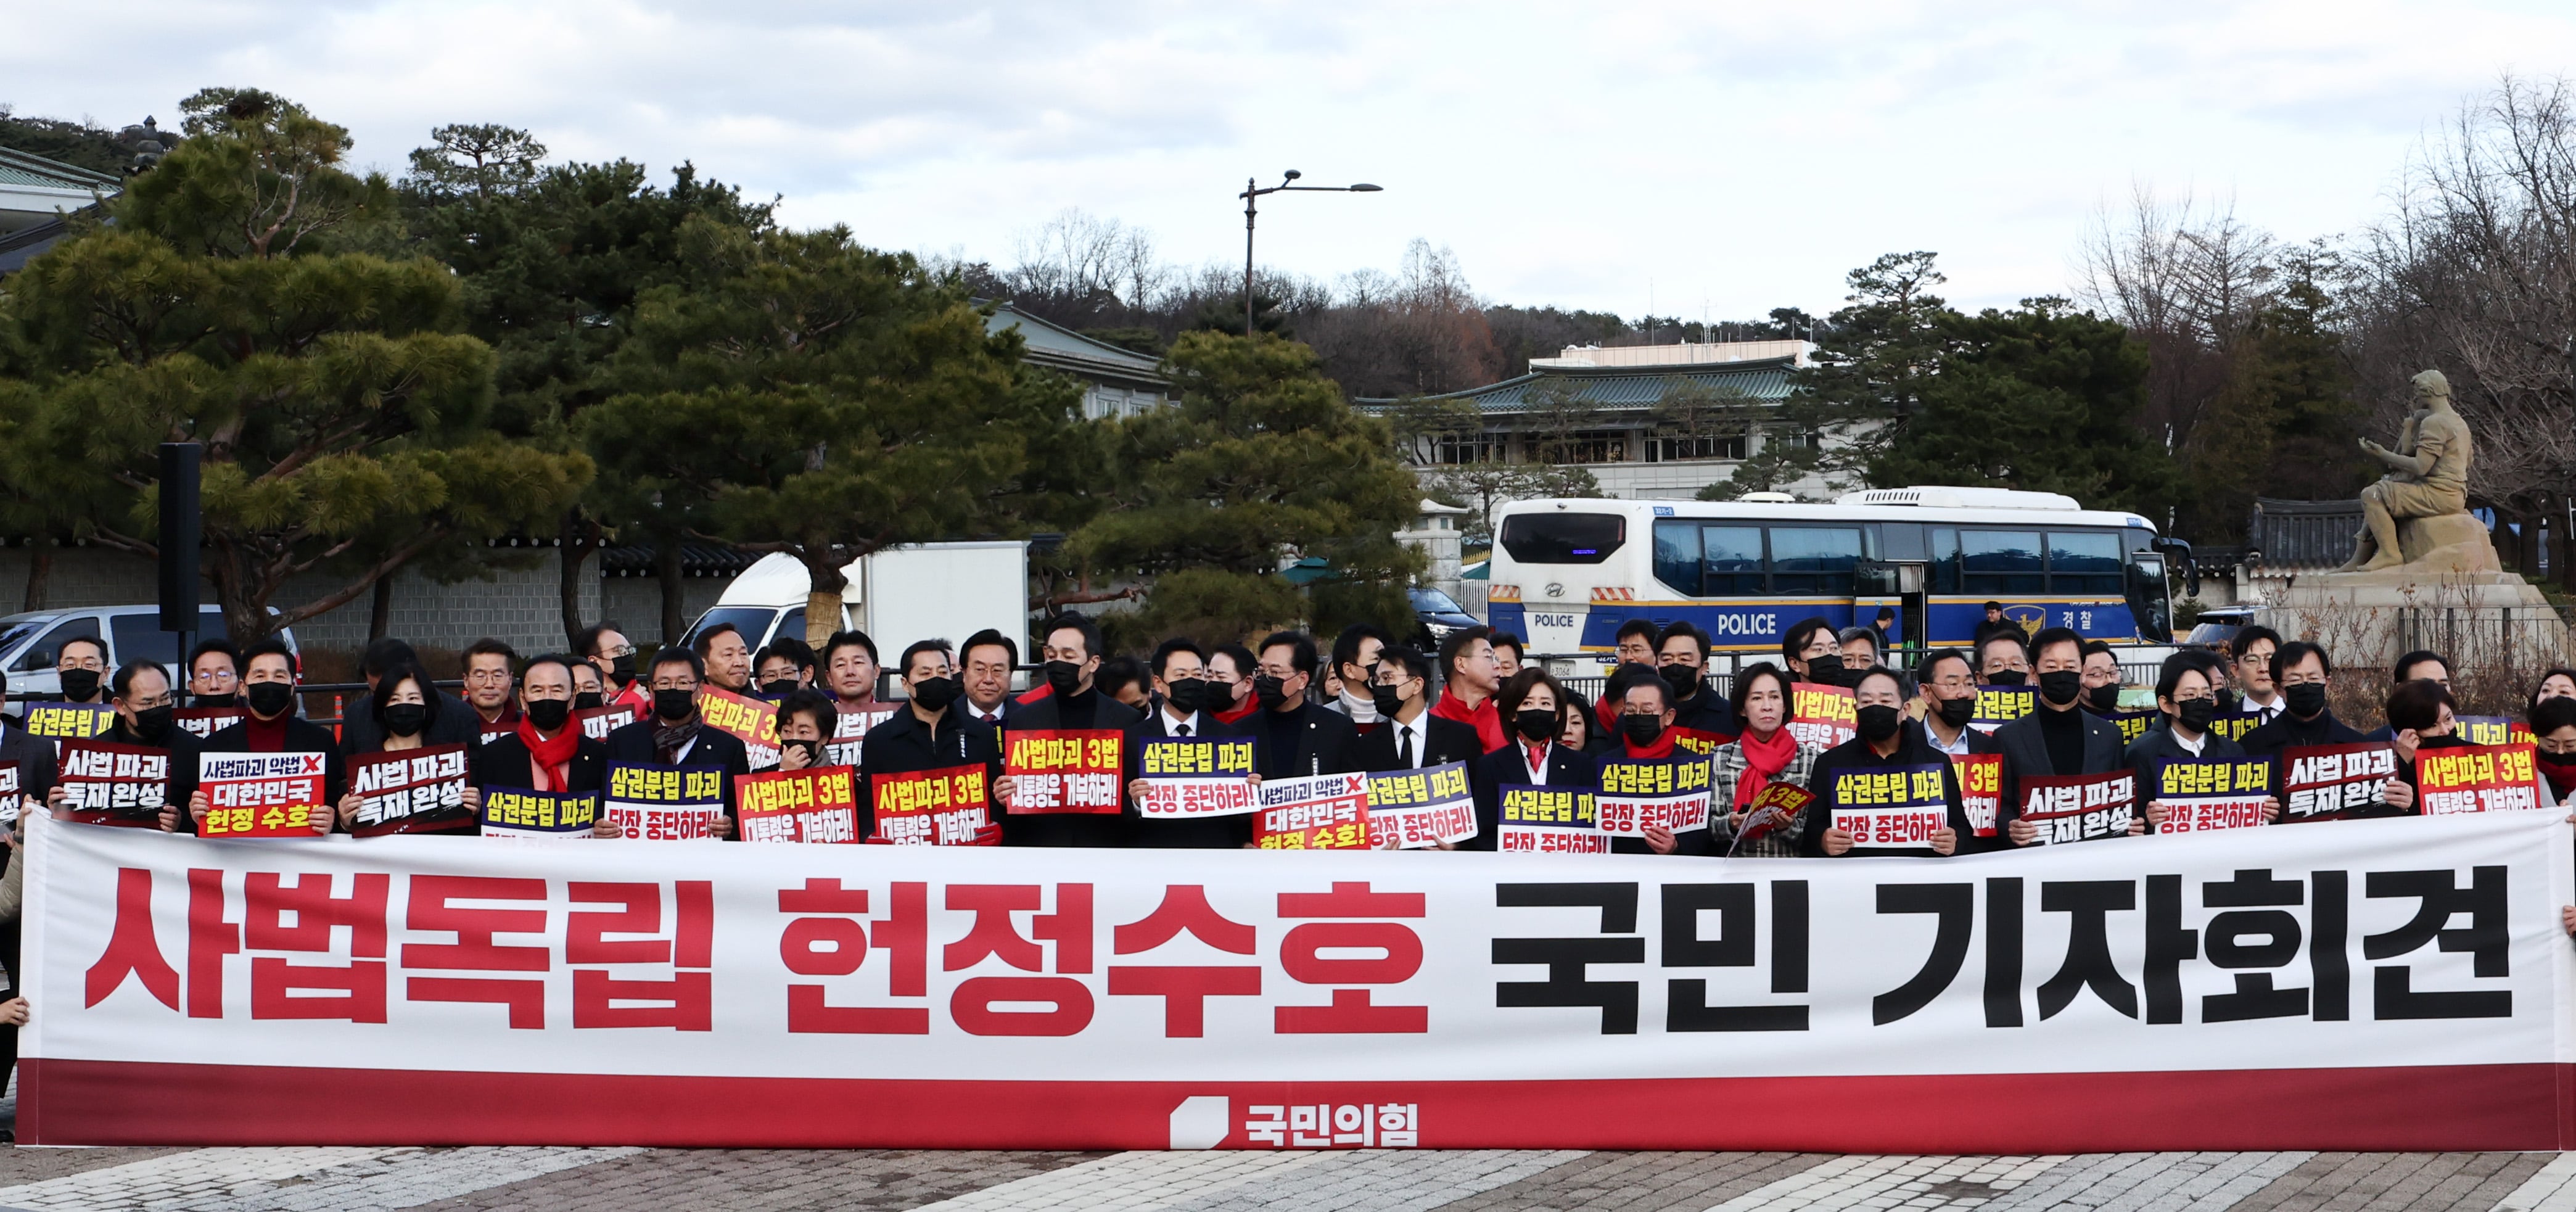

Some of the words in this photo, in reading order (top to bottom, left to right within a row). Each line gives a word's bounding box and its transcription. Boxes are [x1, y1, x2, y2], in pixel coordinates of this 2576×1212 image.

[1535, 614, 1573, 627] POLICE
[1718, 614, 1776, 635] POLICE
[2063, 610, 2092, 630] 경찰
[28, 708, 94, 737] 삼권분립
[96, 710, 115, 735] 파
[760, 714, 781, 745] 3
[2472, 722, 2506, 745] 파괴
[64, 749, 113, 778] 사법
[116, 754, 168, 780] 파괴
[204, 758, 266, 780] 사법파괴
[270, 756, 300, 775] 악법
[1010, 738, 1082, 770] 사법파괴
[1087, 738, 1119, 769] 3법
[1143, 742, 1213, 773] 삼권분립
[1217, 742, 1253, 773] 파괴
[2289, 753, 2342, 786] 사법
[2345, 749, 2397, 778] 파괴
[2423, 752, 2495, 788] 사법파괴
[2500, 749, 2533, 782] 3법
[0, 767, 20, 793] 괴
[355, 759, 409, 794] 사법
[411, 750, 467, 781] 파괴
[611, 767, 680, 800] 삼권분립
[685, 770, 721, 800] 파괴
[1315, 777, 1343, 797] 악법
[1432, 767, 1468, 799] 파괴
[1602, 764, 1673, 794] 삼권분립
[1677, 759, 1710, 791] 파괴
[1835, 772, 1907, 804] 삼권분립
[1912, 769, 1944, 802] 파괴
[1970, 762, 1999, 792] 3법
[2162, 763, 2231, 794] 삼권분립
[2235, 761, 2269, 791] 파괴
[61, 782, 112, 811] 독재
[112, 782, 165, 808] 완성
[213, 780, 312, 807] 대한민국
[357, 789, 411, 826] 독재
[412, 778, 465, 814] 완성
[743, 775, 814, 812] 사법파괴
[818, 772, 851, 806] 3법
[879, 775, 950, 812] 사법파괴
[955, 772, 984, 804] 3법
[1011, 773, 1060, 808] 대통령은
[1064, 773, 1117, 807] 거부하라!
[1146, 784, 1177, 812] 당장
[1183, 783, 1254, 812] 중단하라!
[1503, 789, 1572, 822] 삼권분립
[1578, 793, 1595, 823] 파
[2027, 785, 2082, 814] 사법
[2084, 776, 2134, 807] 파괴
[2289, 786, 2342, 818] 독재
[0, 794, 20, 820] 성
[206, 807, 255, 834] 헌정
[261, 804, 319, 830] 수호
[487, 792, 555, 827] 삼권분립
[560, 796, 595, 827] 파괴
[1265, 798, 1357, 832] 대한민국
[1602, 802, 1634, 832] 당장
[1639, 798, 1705, 832] 중단하라!
[1962, 796, 1997, 829] 하라!
[2083, 803, 2133, 835] 완성
[2197, 801, 2265, 831] 중단하라!
[1312, 823, 1365, 849] 수호!
[1404, 806, 1472, 841] 중단하라!
[85, 867, 714, 1032] 사법독립
[778, 878, 1428, 1038] 헌정수호
[1491, 880, 1809, 1035] 국민
[1872, 865, 2512, 1028] 기자회견
[1245, 1102, 1418, 1148] 국민의힘
